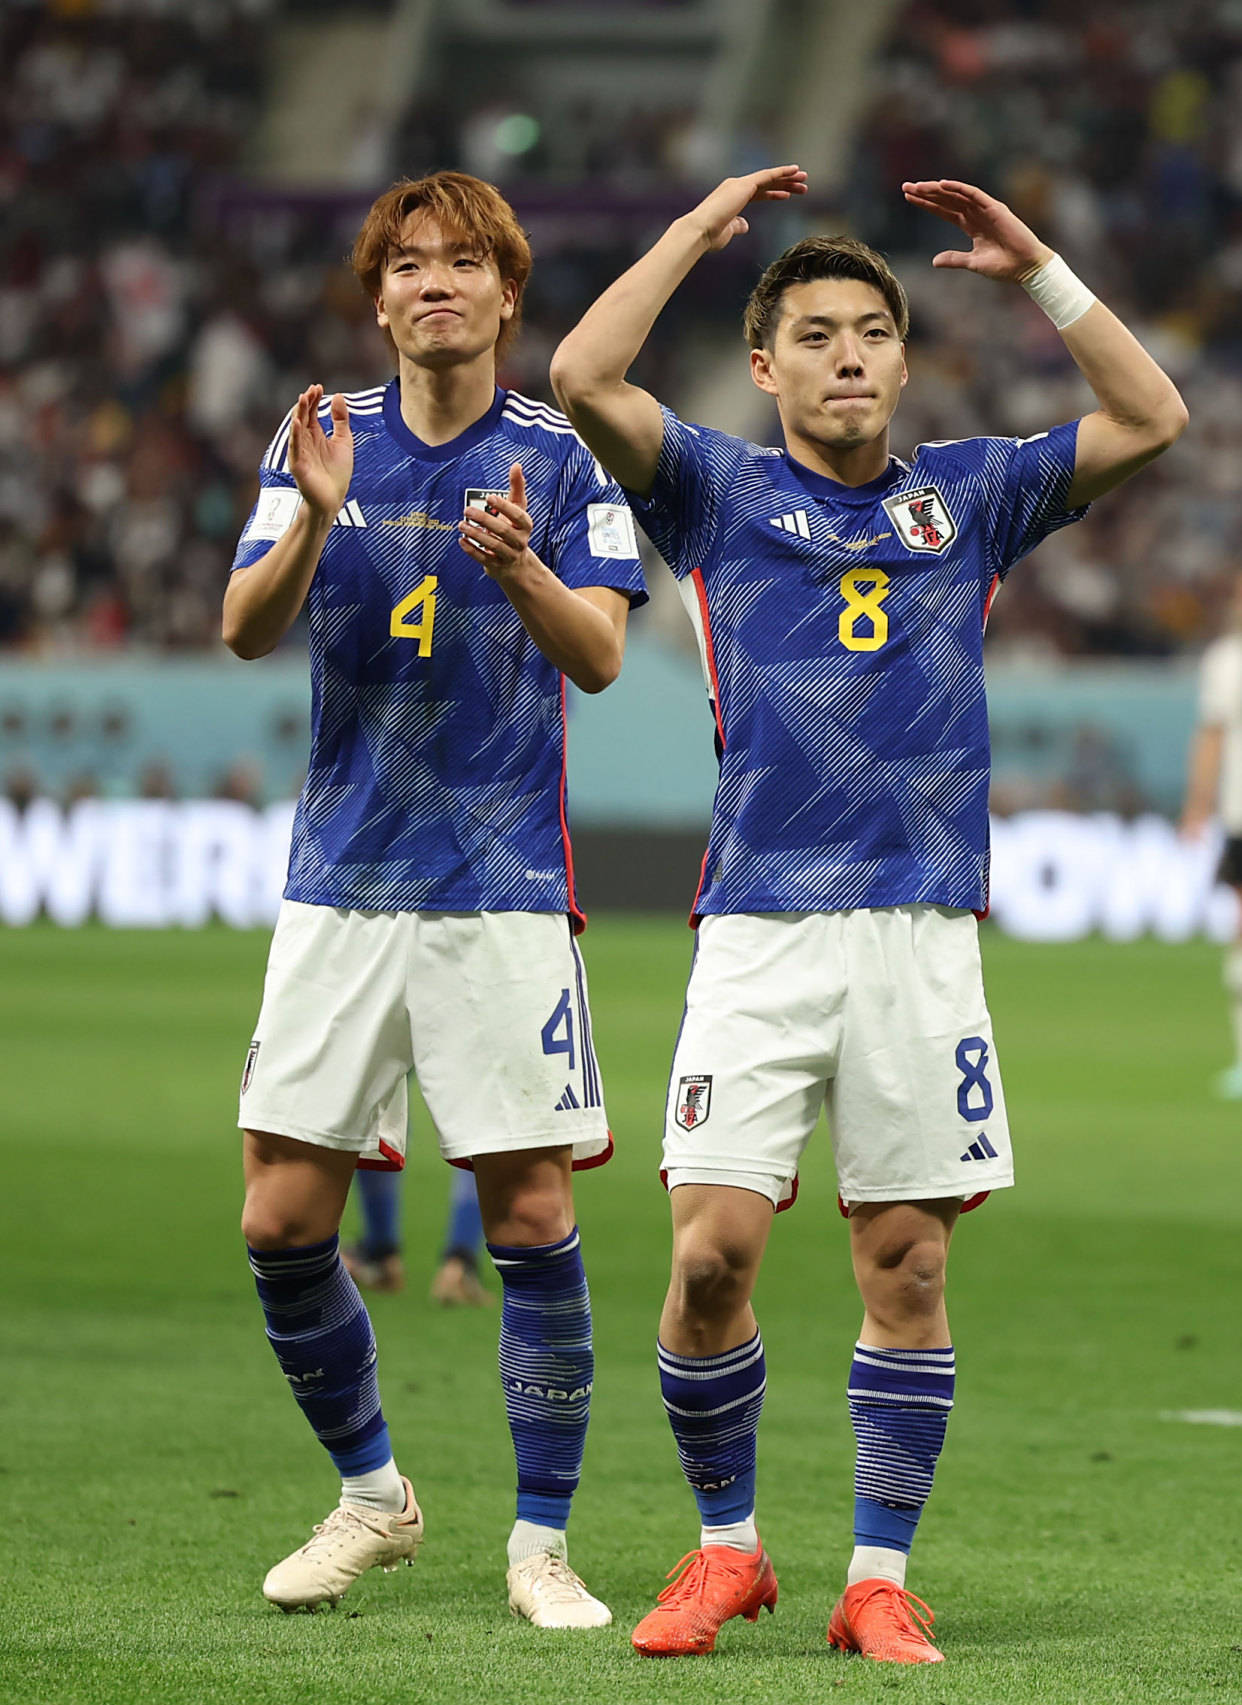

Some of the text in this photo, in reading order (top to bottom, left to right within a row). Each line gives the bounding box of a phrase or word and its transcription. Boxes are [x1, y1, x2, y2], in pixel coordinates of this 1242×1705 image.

[898, 489, 926, 503] JAPAN
[921, 530, 944, 545] JFA
[390, 575, 438, 658] 4
[839, 568, 890, 652] 8
[541, 988, 575, 1070] 4
[955, 1036, 994, 1123] 8
[510, 1381, 593, 1401] JAPAN
